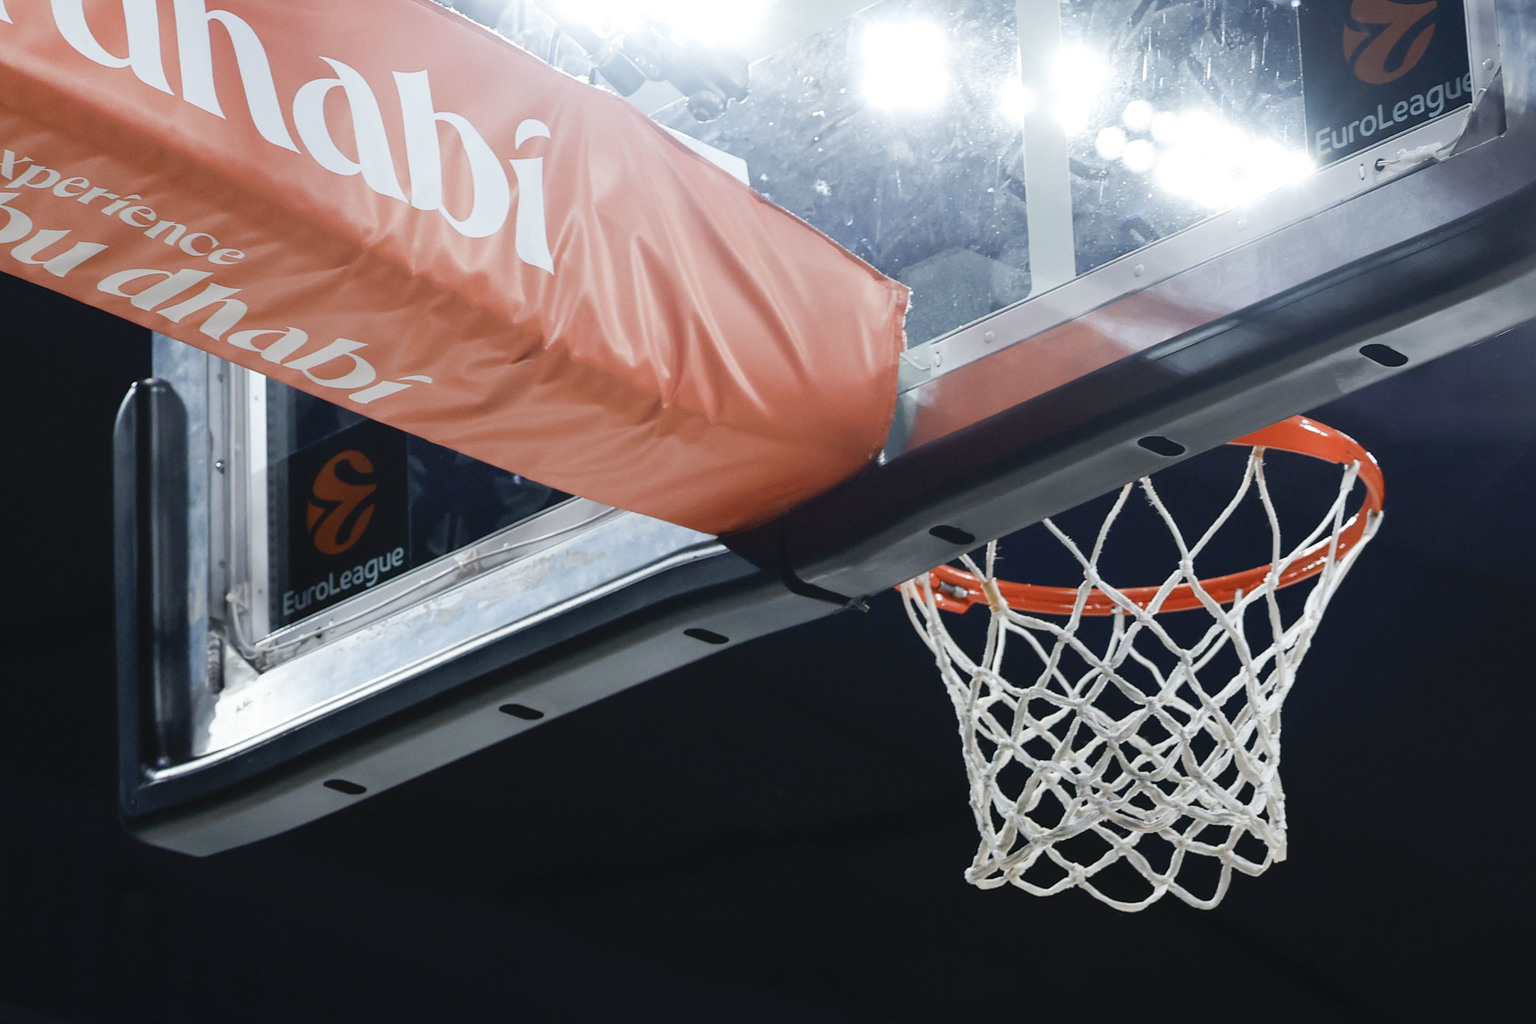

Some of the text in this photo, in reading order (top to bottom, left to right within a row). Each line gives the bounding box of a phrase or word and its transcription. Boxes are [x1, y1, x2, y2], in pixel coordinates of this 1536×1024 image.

[1315, 71, 1472, 156] EuroLeague
[97, 268, 433, 405] dhabi
[282, 546, 405, 617] EuroLeague
